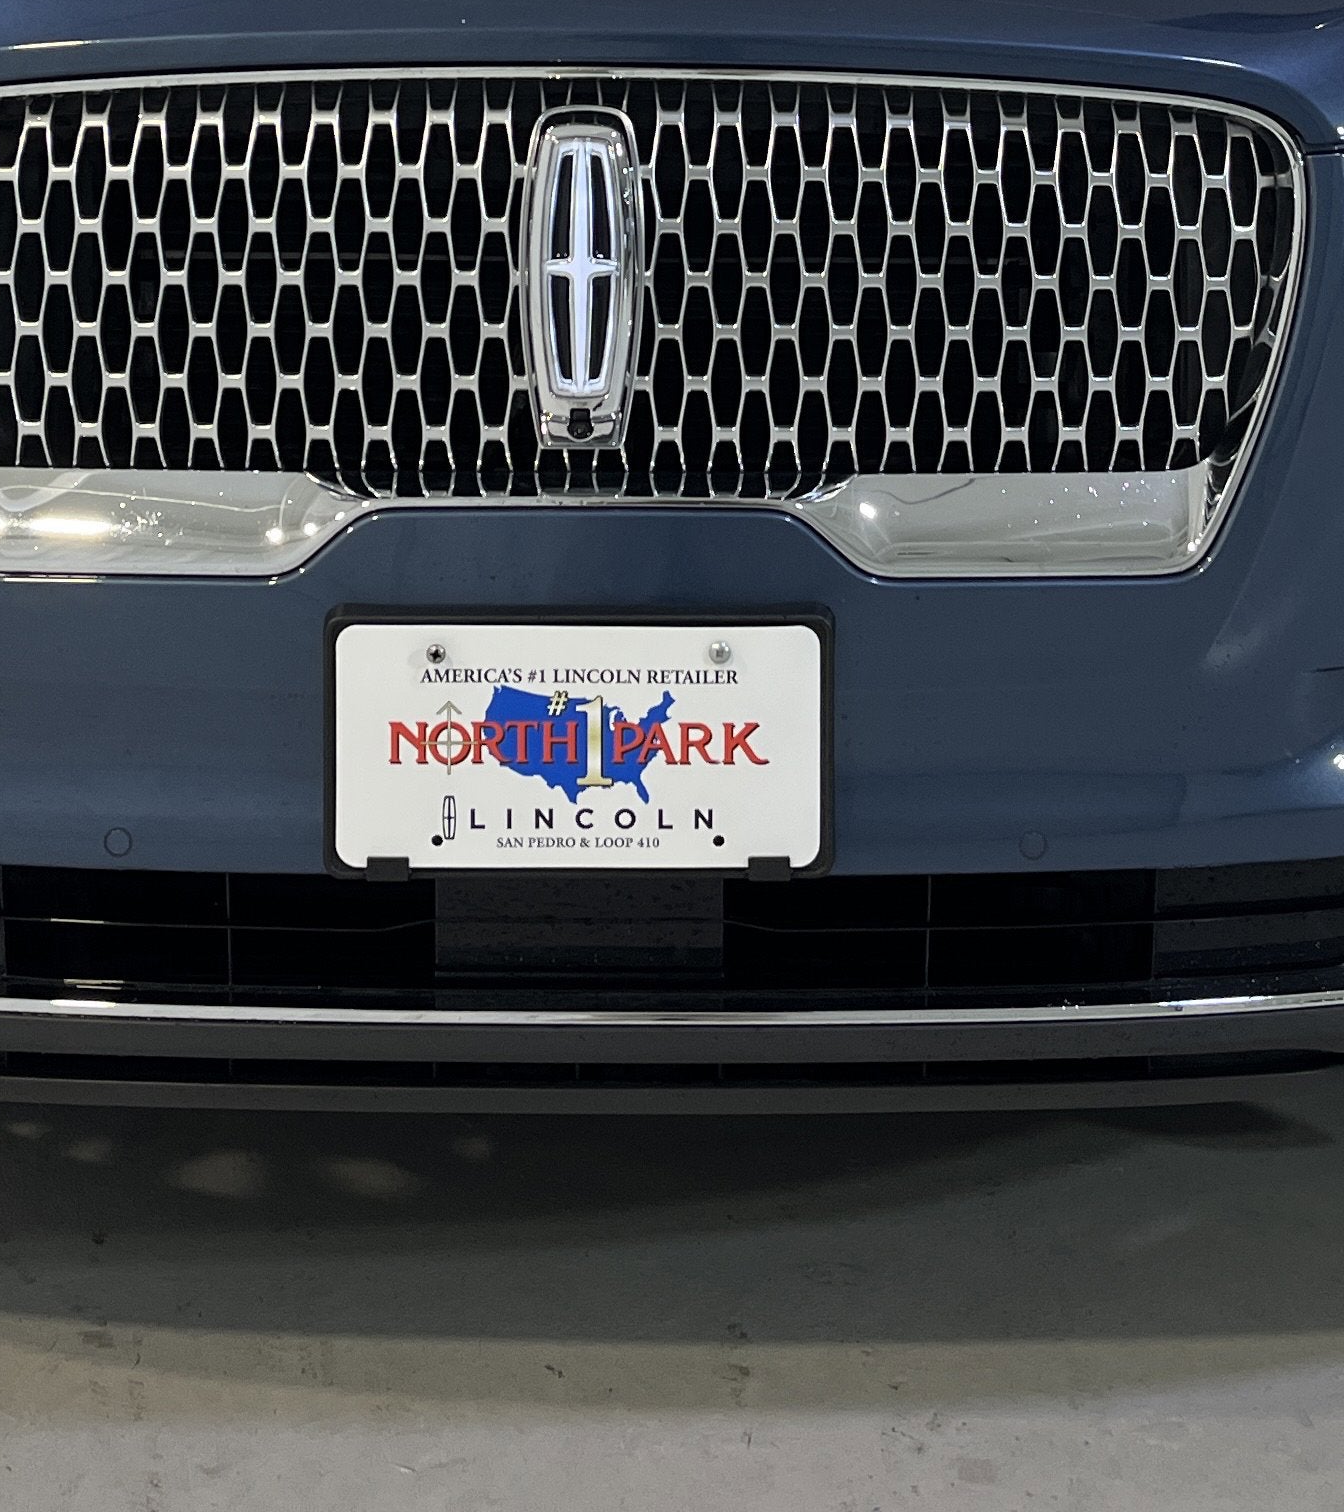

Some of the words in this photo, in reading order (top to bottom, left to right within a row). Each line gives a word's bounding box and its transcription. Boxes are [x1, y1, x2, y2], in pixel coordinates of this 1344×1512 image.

[420, 668, 523, 684] AMERICA'S
[527, 669, 547, 684] #1
[552, 668, 641, 684] LINCOLN
[647, 669, 738, 685] RETAILER
[388, 719, 578, 766] NORTH
[611, 721, 770, 766] PARK
[470, 807, 715, 830] LINCOLN
[496, 836, 524, 849] SAN
[528, 836, 576, 849] PEDRO
[579, 836, 591, 849] &
[594, 836, 634, 849] LOOP
[637, 836, 660, 849] 410
